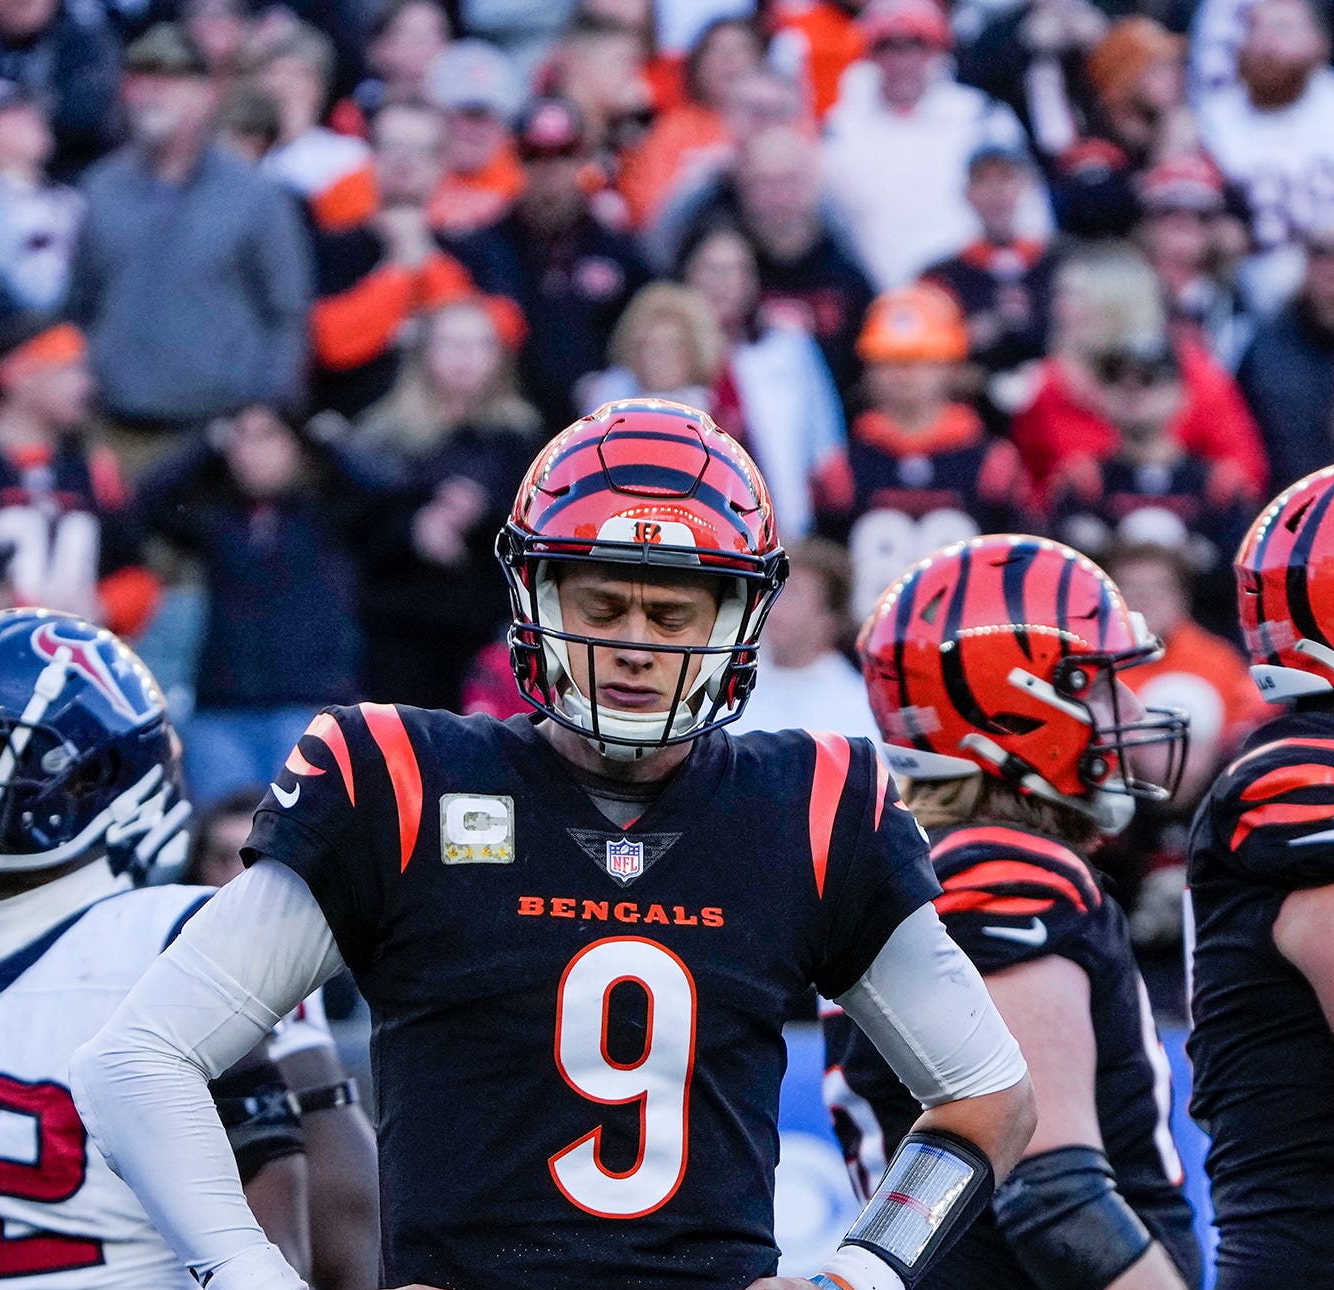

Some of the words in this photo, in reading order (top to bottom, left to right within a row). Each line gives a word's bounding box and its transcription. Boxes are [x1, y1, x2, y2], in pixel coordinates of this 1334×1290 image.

[446, 799, 509, 845] C
[612, 855, 638, 874] NFL
[518, 896, 725, 927] BENGALS
[548, 935, 698, 1220] 9
